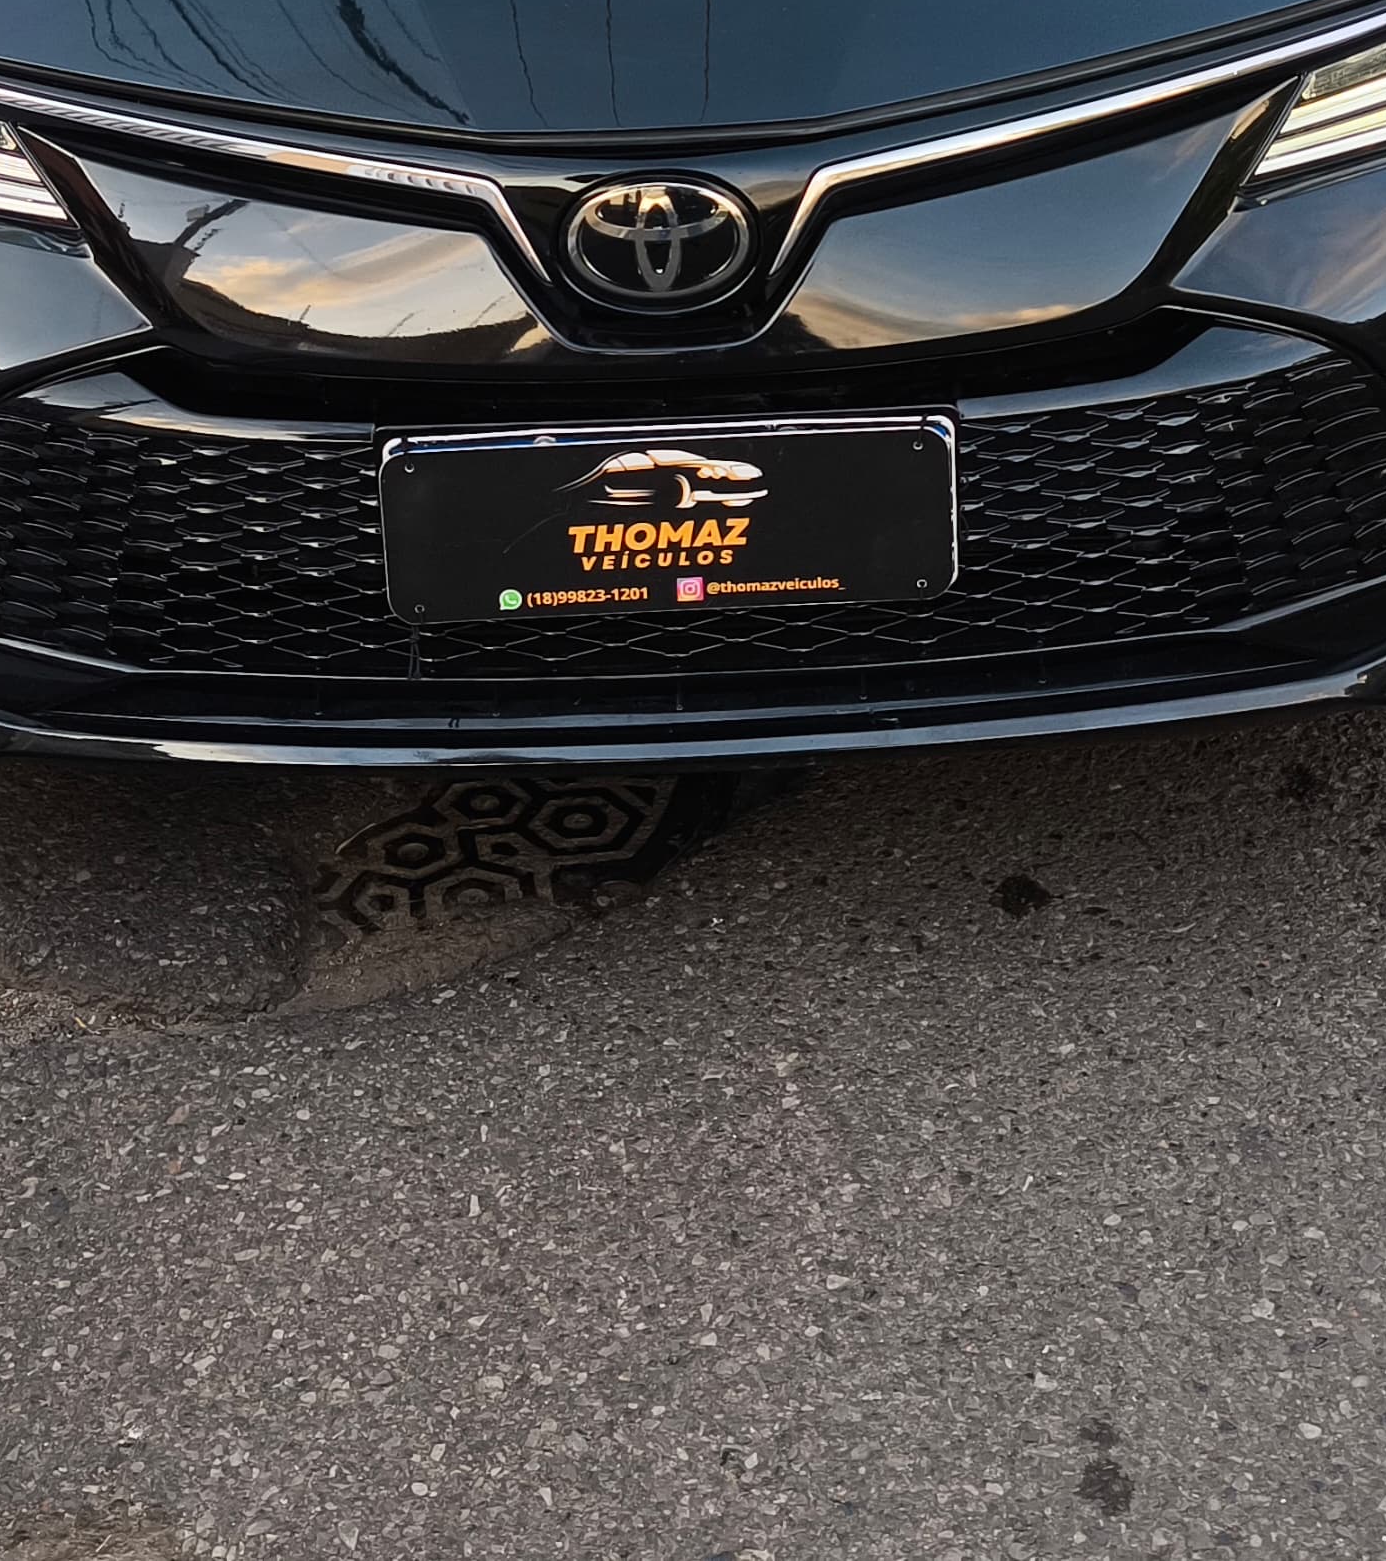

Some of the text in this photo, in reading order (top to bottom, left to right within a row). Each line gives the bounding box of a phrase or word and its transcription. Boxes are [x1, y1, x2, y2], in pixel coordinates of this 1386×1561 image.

[567, 516, 751, 554] THOMAZ
[580, 549, 735, 571] VEÍCULOS
[526, 586, 649, 608] (18)99823-1201
